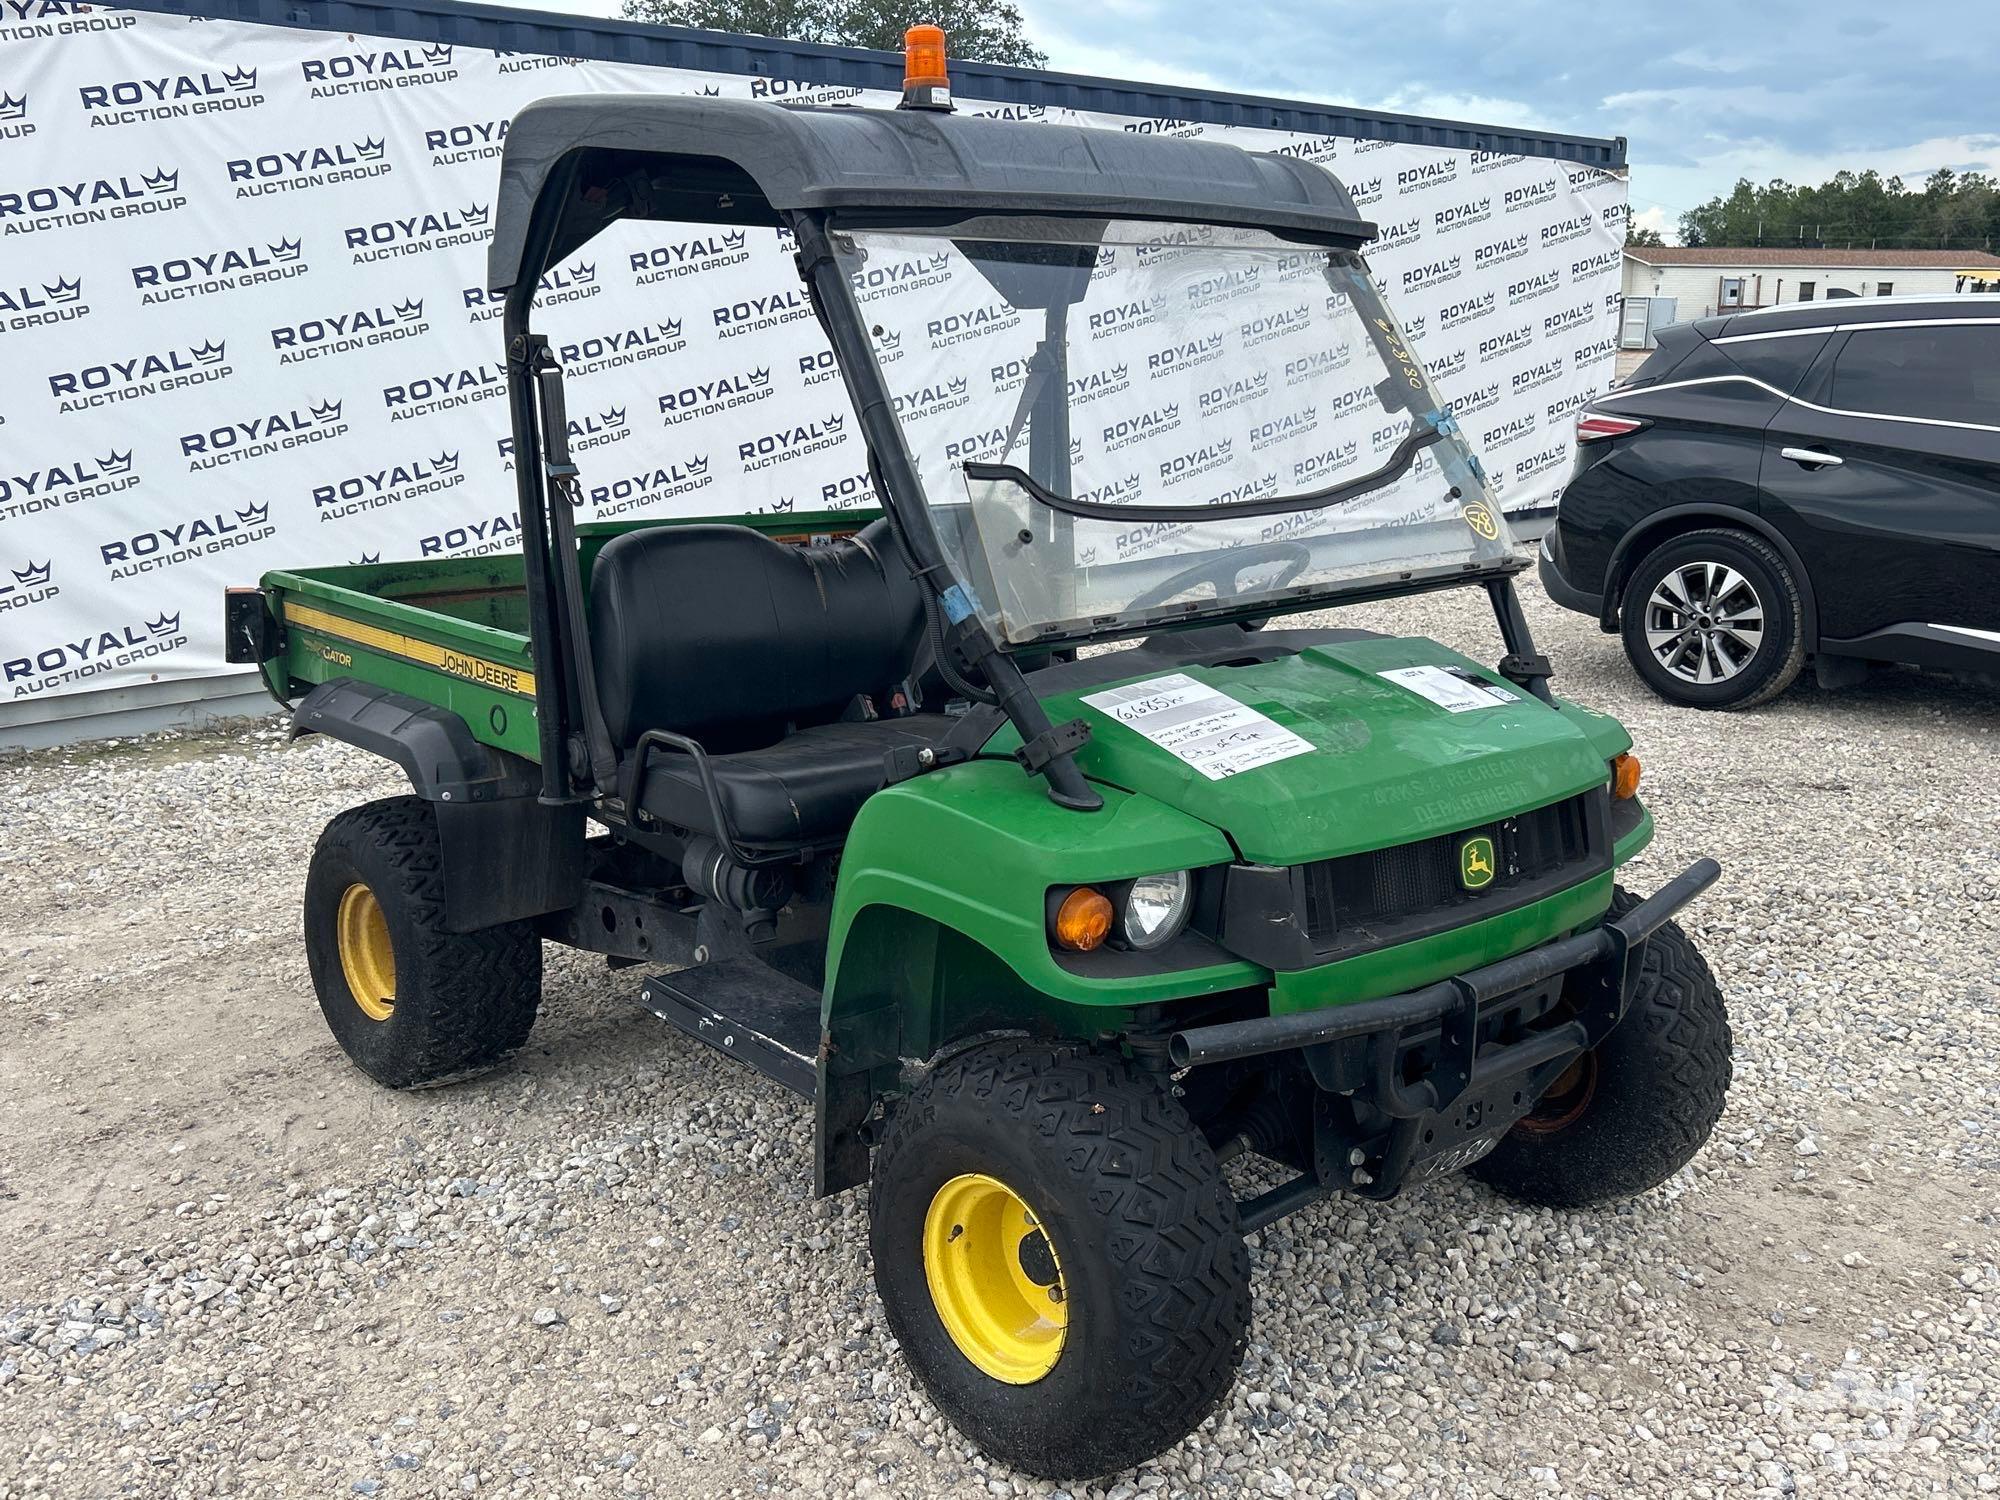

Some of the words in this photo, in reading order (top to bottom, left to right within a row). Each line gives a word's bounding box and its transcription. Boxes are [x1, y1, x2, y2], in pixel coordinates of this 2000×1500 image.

[58, 16, 137, 35] GROUP
[301, 51, 424, 81] ROYAL
[79, 73, 225, 110] ROYAL
[310, 78, 393, 97] AUCTION
[396, 70, 458, 87] GROUP
[90, 104, 188, 128] AUCTION
[192, 95, 265, 114] GROUP
[226, 145, 356, 182] ROYAL
[1397, 163, 1444, 186] ROYAL
[236, 175, 324, 199] AUCTION
[327, 163, 392, 184] GROUP
[1399, 180, 1431, 196] AUCTION
[1432, 173, 1456, 186] GROUP
[1504, 183, 1546, 205] ROYAL
[0, 177, 145, 218] ROYAL
[1505, 199, 1534, 214] AUCTION
[1535, 193, 1556, 205] GROUP
[4, 209, 106, 236] AUCTION
[110, 196, 186, 219] GROUP
[1435, 202, 1479, 226] ROYAL
[1436, 219, 1467, 235] AUCTION
[1468, 212, 1491, 225] GROUP
[1541, 218, 1580, 240] ROYAL
[345, 212, 461, 249] ROYAL
[1542, 235, 1569, 249] AUCTION
[1570, 228, 1591, 240] GROUP
[352, 240, 431, 265] AUCTION
[434, 228, 492, 248] GROUP
[629, 238, 723, 272] ROYAL
[1474, 239, 1517, 262] ROYAL
[1476, 255, 1505, 271] AUCTION
[1506, 248, 1528, 261] GROUP
[131, 247, 271, 289] ROYAL
[635, 263, 699, 286] AUCTION
[701, 252, 749, 271] GROUP
[1402, 261, 1449, 286] ROYAL
[1571, 253, 1610, 275] ROYAL
[1572, 269, 1599, 284] AUCTION
[1600, 262, 1620, 274] GROUP
[142, 278, 235, 306] AUCTION
[239, 264, 308, 287] GROUP
[546, 285, 601, 306] GROUP
[1404, 278, 1436, 295] AUCTION
[1437, 270, 1461, 284] GROUP
[1508, 274, 1549, 298] ROYAL
[1509, 291, 1537, 307] AUCTION
[1538, 283, 1559, 296] GROUP
[713, 293, 803, 326] ROYAL
[927, 306, 1001, 338] ROYAL
[1089, 300, 1151, 330] ROYAL
[1240, 311, 1295, 339] ROYAL
[1440, 297, 1484, 322] ROYAL
[1441, 314, 1471, 331] AUCTION
[1472, 306, 1495, 320] GROUP
[1544, 307, 1583, 330] ROYAL
[270, 308, 395, 350] ROYAL
[718, 317, 779, 340] AUCTION
[931, 328, 982, 350] AUCTION
[983, 317, 1020, 335] GROUP
[1092, 321, 1135, 341] AUCTION
[1242, 330, 1280, 349] AUCTION
[1281, 320, 1309, 336] GROUP
[1479, 330, 1521, 355] ROYAL
[1545, 323, 1572, 339] AUCTION
[1573, 315, 1593, 328] GROUP
[280, 337, 364, 365] AUCTION
[367, 323, 429, 345] GROUP
[560, 327, 659, 365] ROYAL
[567, 353, 634, 379] AUCTION
[636, 340, 686, 360] GROUP
[1148, 339, 1208, 370] ROYAL
[1480, 347, 1509, 364] AUCTION
[1510, 338, 1532, 352] GROUP
[48, 351, 193, 397] ROYAL
[1150, 360, 1192, 380] AUCTION
[1193, 349, 1224, 366] GROUP
[1285, 349, 1337, 377] ROYAL
[1287, 368, 1323, 387] AUCTION
[1324, 358, 1351, 373] GROUP
[1512, 363, 1552, 388] ROYAL
[59, 383, 156, 414] AUCTION
[160, 366, 232, 391] GROUP
[383, 367, 498, 407] ROYAL
[657, 376, 749, 414] ROYAL
[1198, 378, 1254, 408] ROYAL
[1513, 380, 1541, 396] AUCTION
[1541, 371, 1562, 384] GROUP
[391, 396, 469, 422] AUCTION
[664, 401, 725, 427] AUCTION
[727, 388, 773, 408] GROUP
[1201, 398, 1239, 419] AUCTION
[1240, 387, 1268, 404] GROUP
[179, 410, 312, 457] ROYAL
[738, 423, 824, 461] ROYAL
[1102, 411, 1163, 443] ROYAL
[1105, 432, 1147, 454] AUCTION
[1148, 420, 1179, 437] GROUP
[1249, 413, 1303, 443] ROYAL
[1251, 432, 1288, 453] AUCTION
[1289, 421, 1317, 438] GROUP
[1483, 419, 1525, 445] ROYAL
[1484, 436, 1513, 454] AUCTION
[1514, 426, 1535, 440] GROUP
[189, 441, 278, 473] AUCTION
[282, 424, 348, 449] GROUP
[743, 448, 801, 474] AUCTION
[803, 434, 846, 454] GROUP
[1160, 446, 1218, 478] ROYAL
[1293, 448, 1344, 477] ROYAL
[1516, 449, 1555, 475] ROYAL
[312, 462, 432, 508] ROYAL
[1162, 466, 1202, 488] AUCTION
[1204, 454, 1233, 471] GROUP
[1295, 466, 1330, 487] AUCTION
[1331, 455, 1357, 471] GROUP
[1517, 465, 1544, 483] AUCTION
[1545, 456, 1565, 470] GROUP
[320, 491, 401, 523] AUCTION
[404, 474, 464, 499] GROUP
[590, 466, 686, 506] ROYAL
[596, 491, 662, 519] AUCTION
[664, 476, 712, 497] GROUP
[99, 514, 238, 565] ROYAL
[110, 546, 203, 581] AUCTION
[206, 526, 275, 554] GROUP
[3, 627, 148, 682] ROYAL
[15, 658, 112, 697] AUCTION
[115, 635, 187, 665] GROUP
[323, 646, 352, 668] GATOR
[440, 651, 473, 676] JOHN
[476, 660, 519, 691] DEERE
